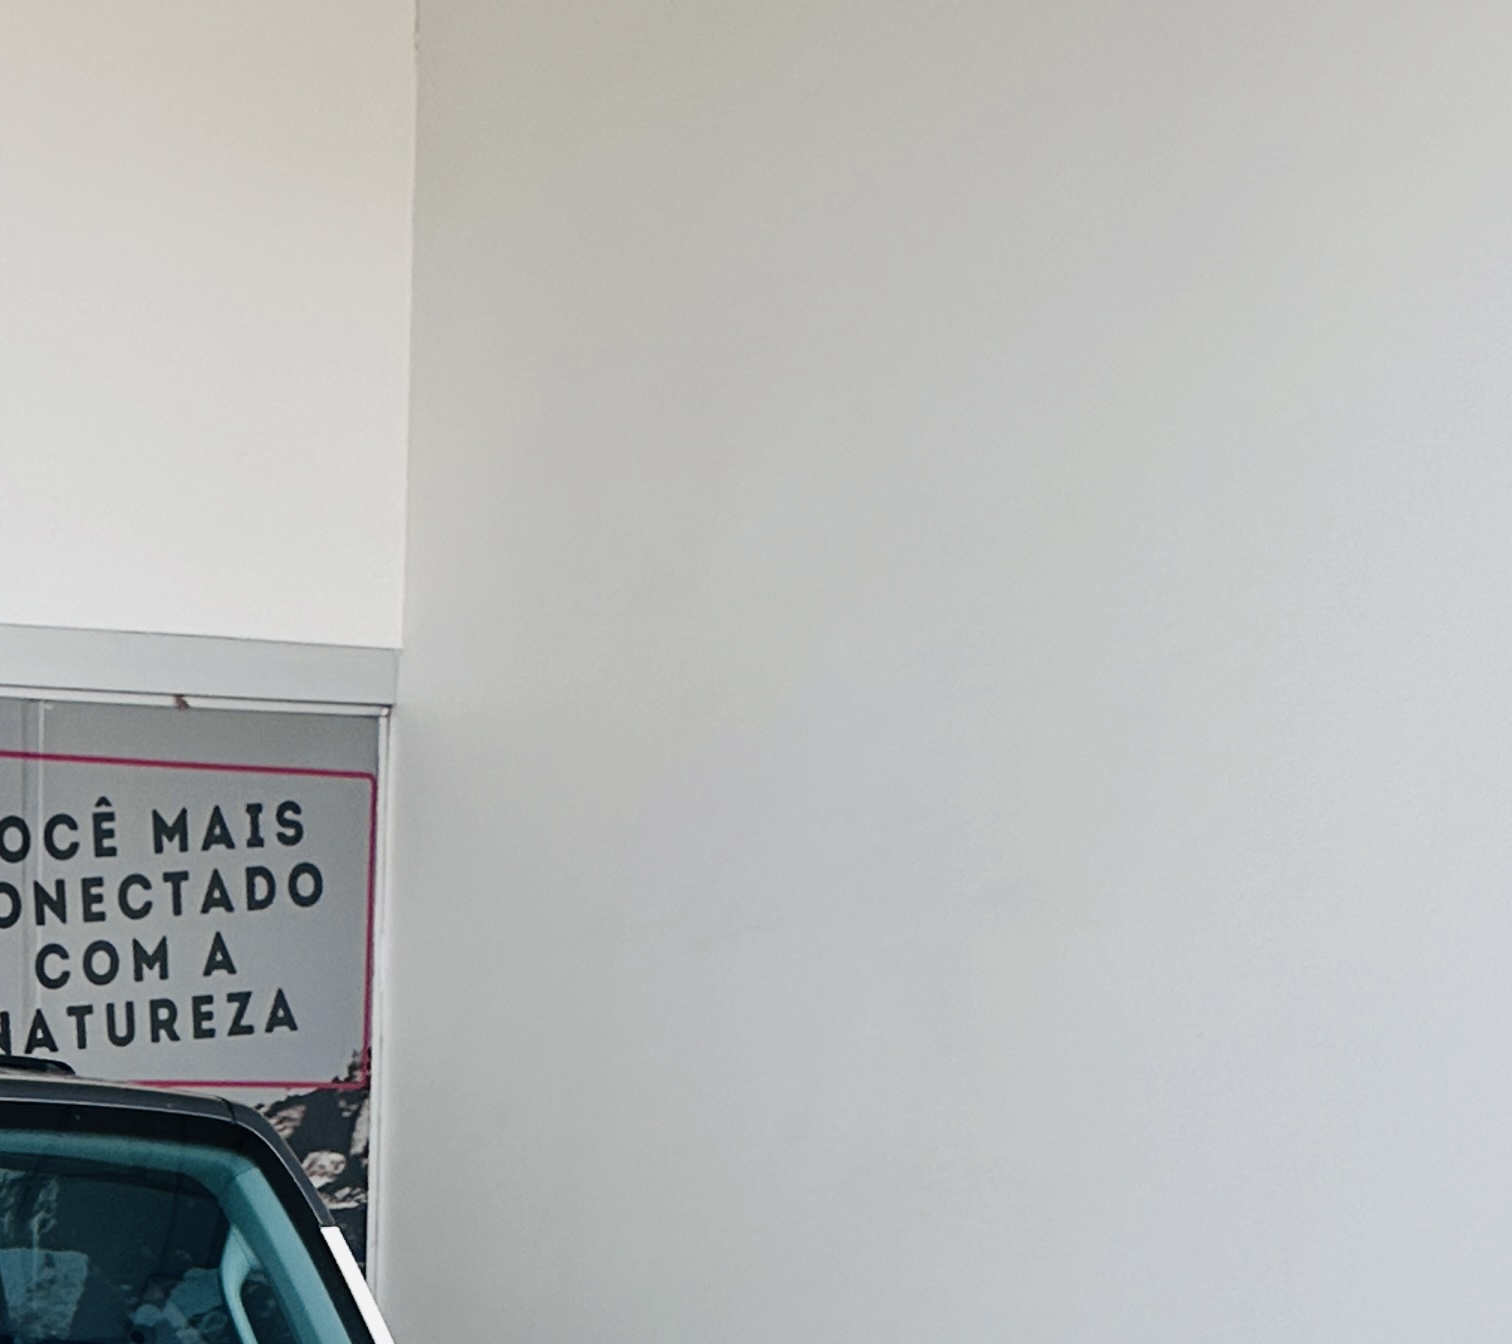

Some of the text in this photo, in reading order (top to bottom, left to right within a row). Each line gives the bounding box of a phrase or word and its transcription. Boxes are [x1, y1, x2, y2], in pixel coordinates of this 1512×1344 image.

[151, 801, 305, 854] MAIS
[35, 931, 237, 989] COM A
